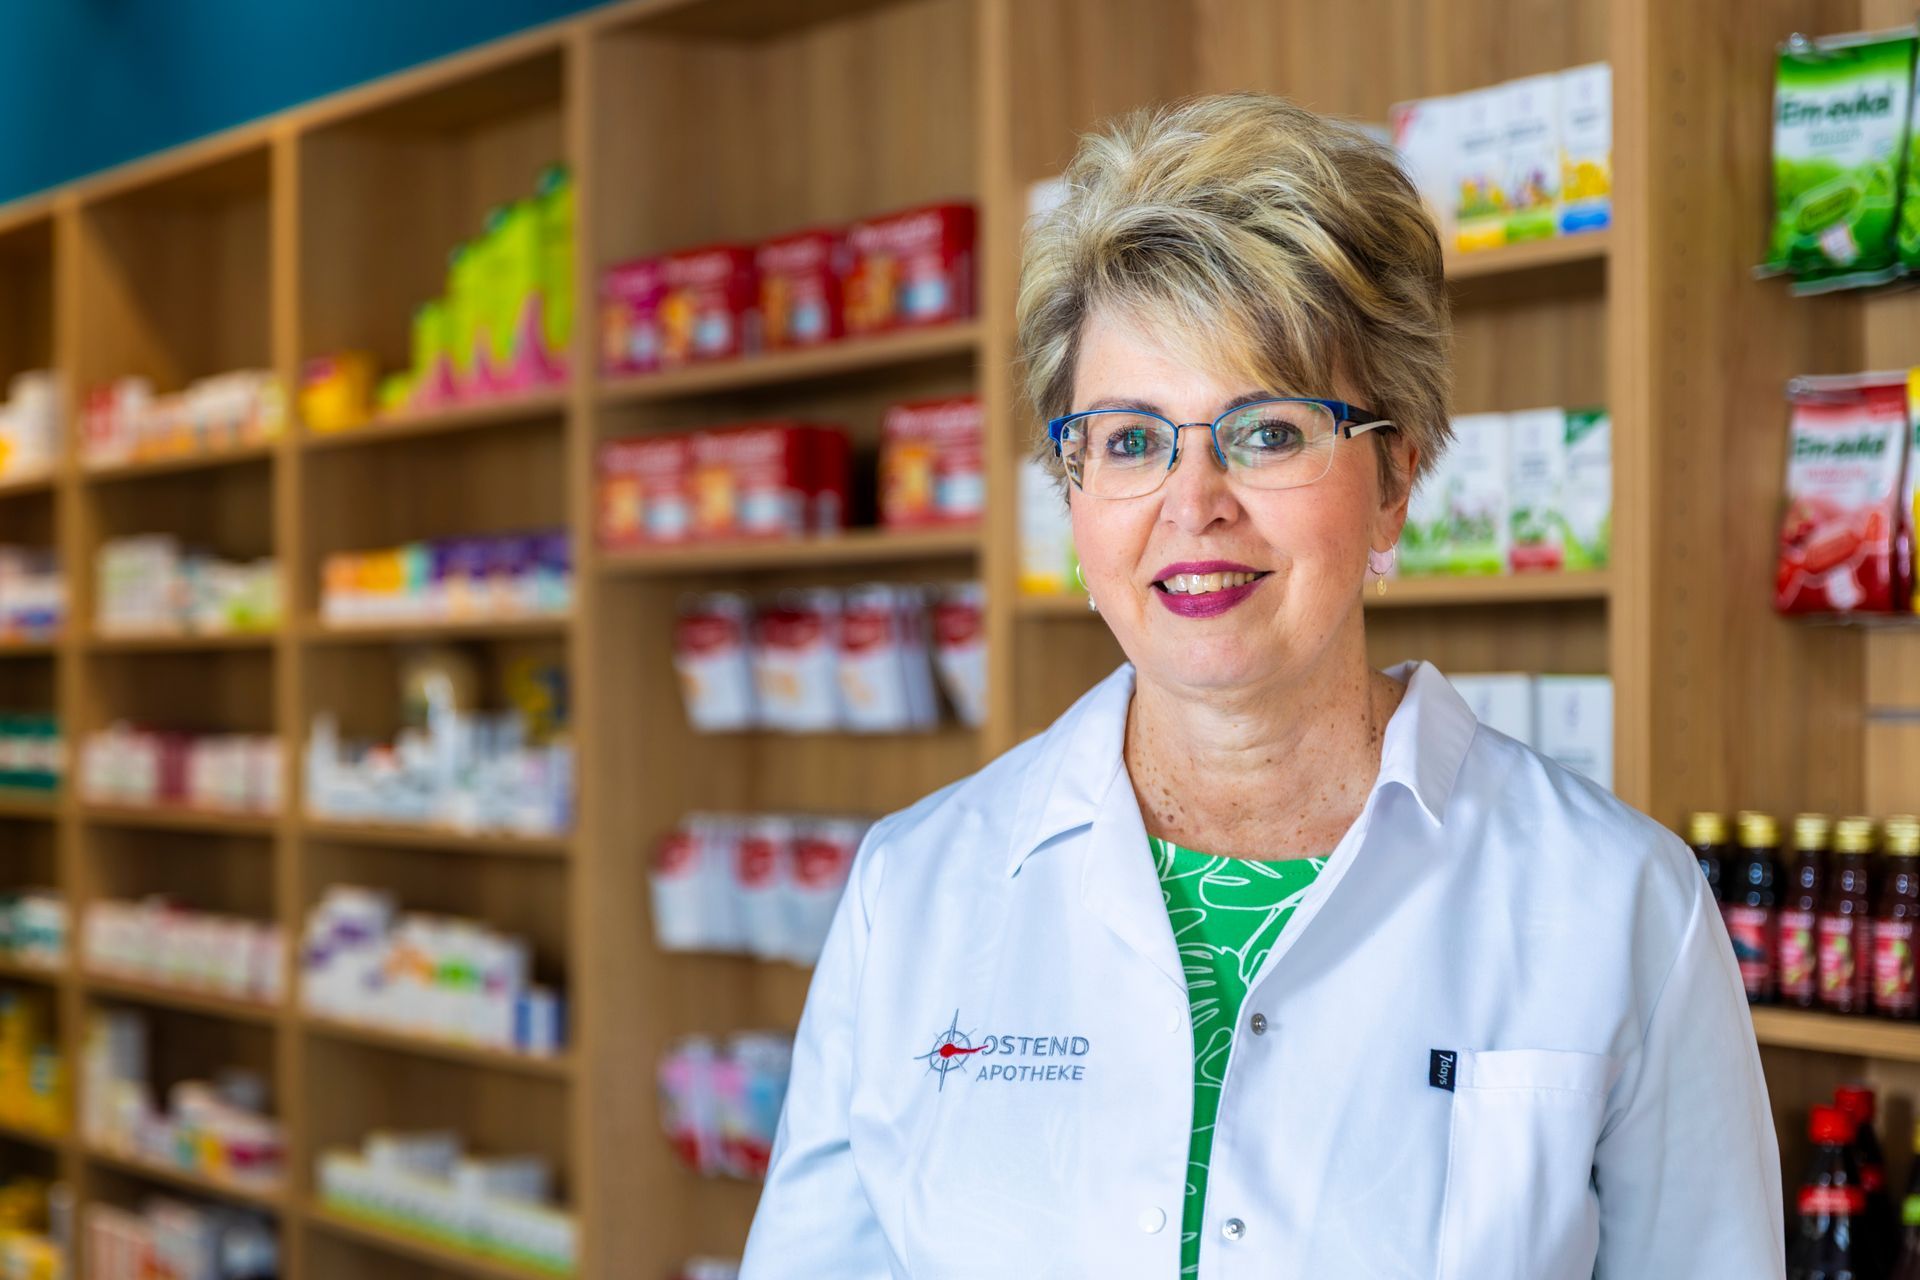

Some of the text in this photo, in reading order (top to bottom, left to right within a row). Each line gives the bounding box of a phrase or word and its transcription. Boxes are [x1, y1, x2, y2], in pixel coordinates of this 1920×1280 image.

[982, 1036, 1090, 1056] OSTEND
[977, 1065, 1085, 1081] APOTHEKE
[1437, 1054, 1453, 1085] 7days
